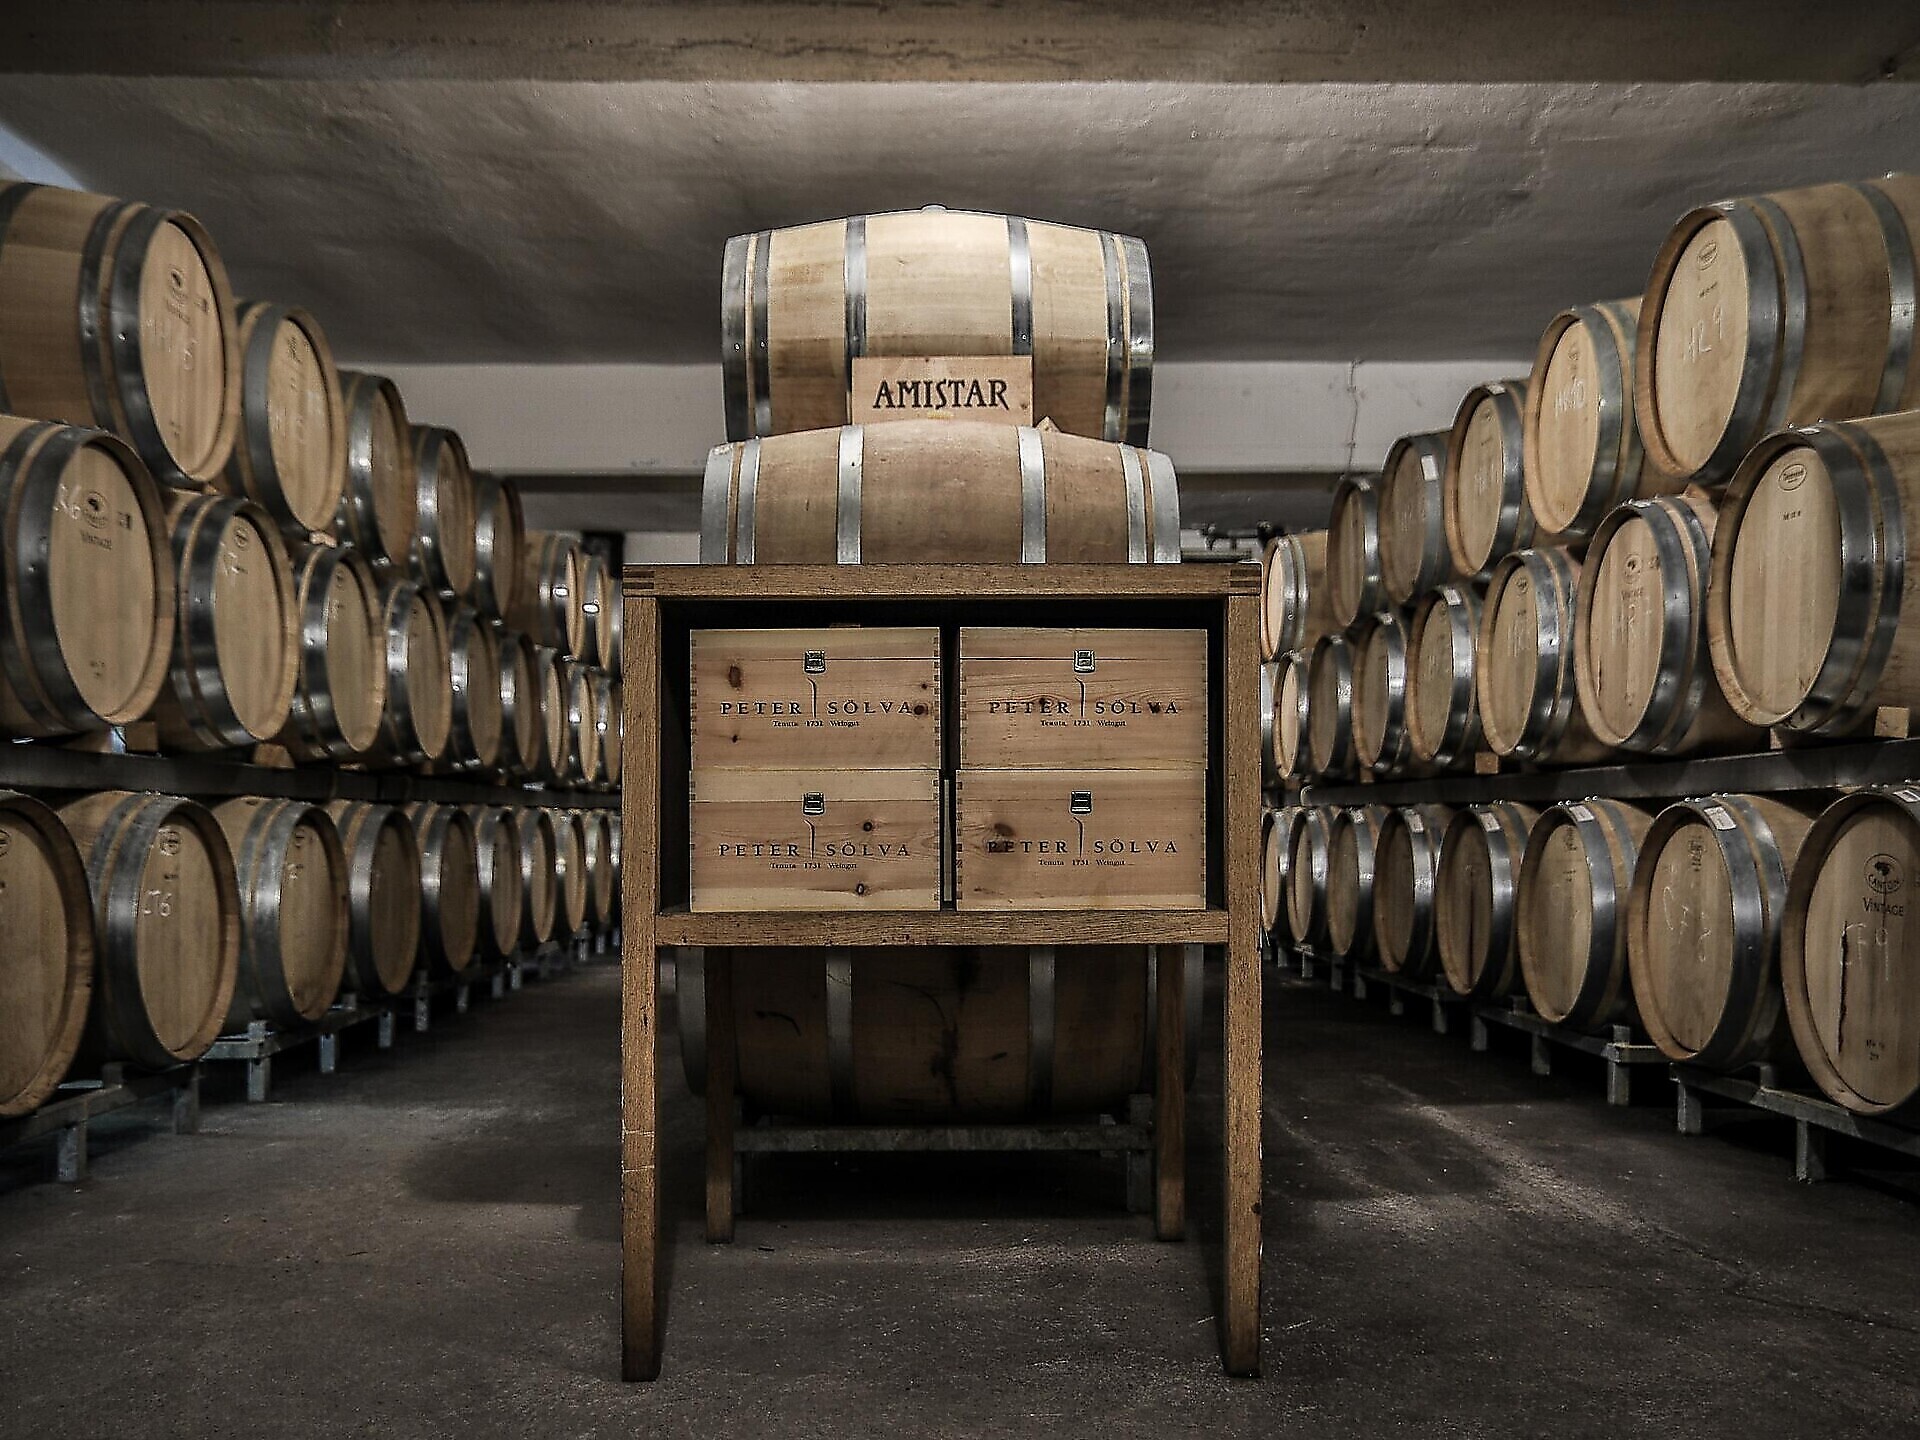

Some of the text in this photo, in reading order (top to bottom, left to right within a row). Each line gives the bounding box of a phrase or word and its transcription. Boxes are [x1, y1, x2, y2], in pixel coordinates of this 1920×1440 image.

[872, 378, 1010, 410] AMISTAR
[720, 699, 913, 715] PETER SÖLVA
[989, 699, 1178, 714] PETER SÖLVA
[719, 842, 910, 857] PETER SÖLVA
[987, 838, 1178, 854] PETER SÖLVA
